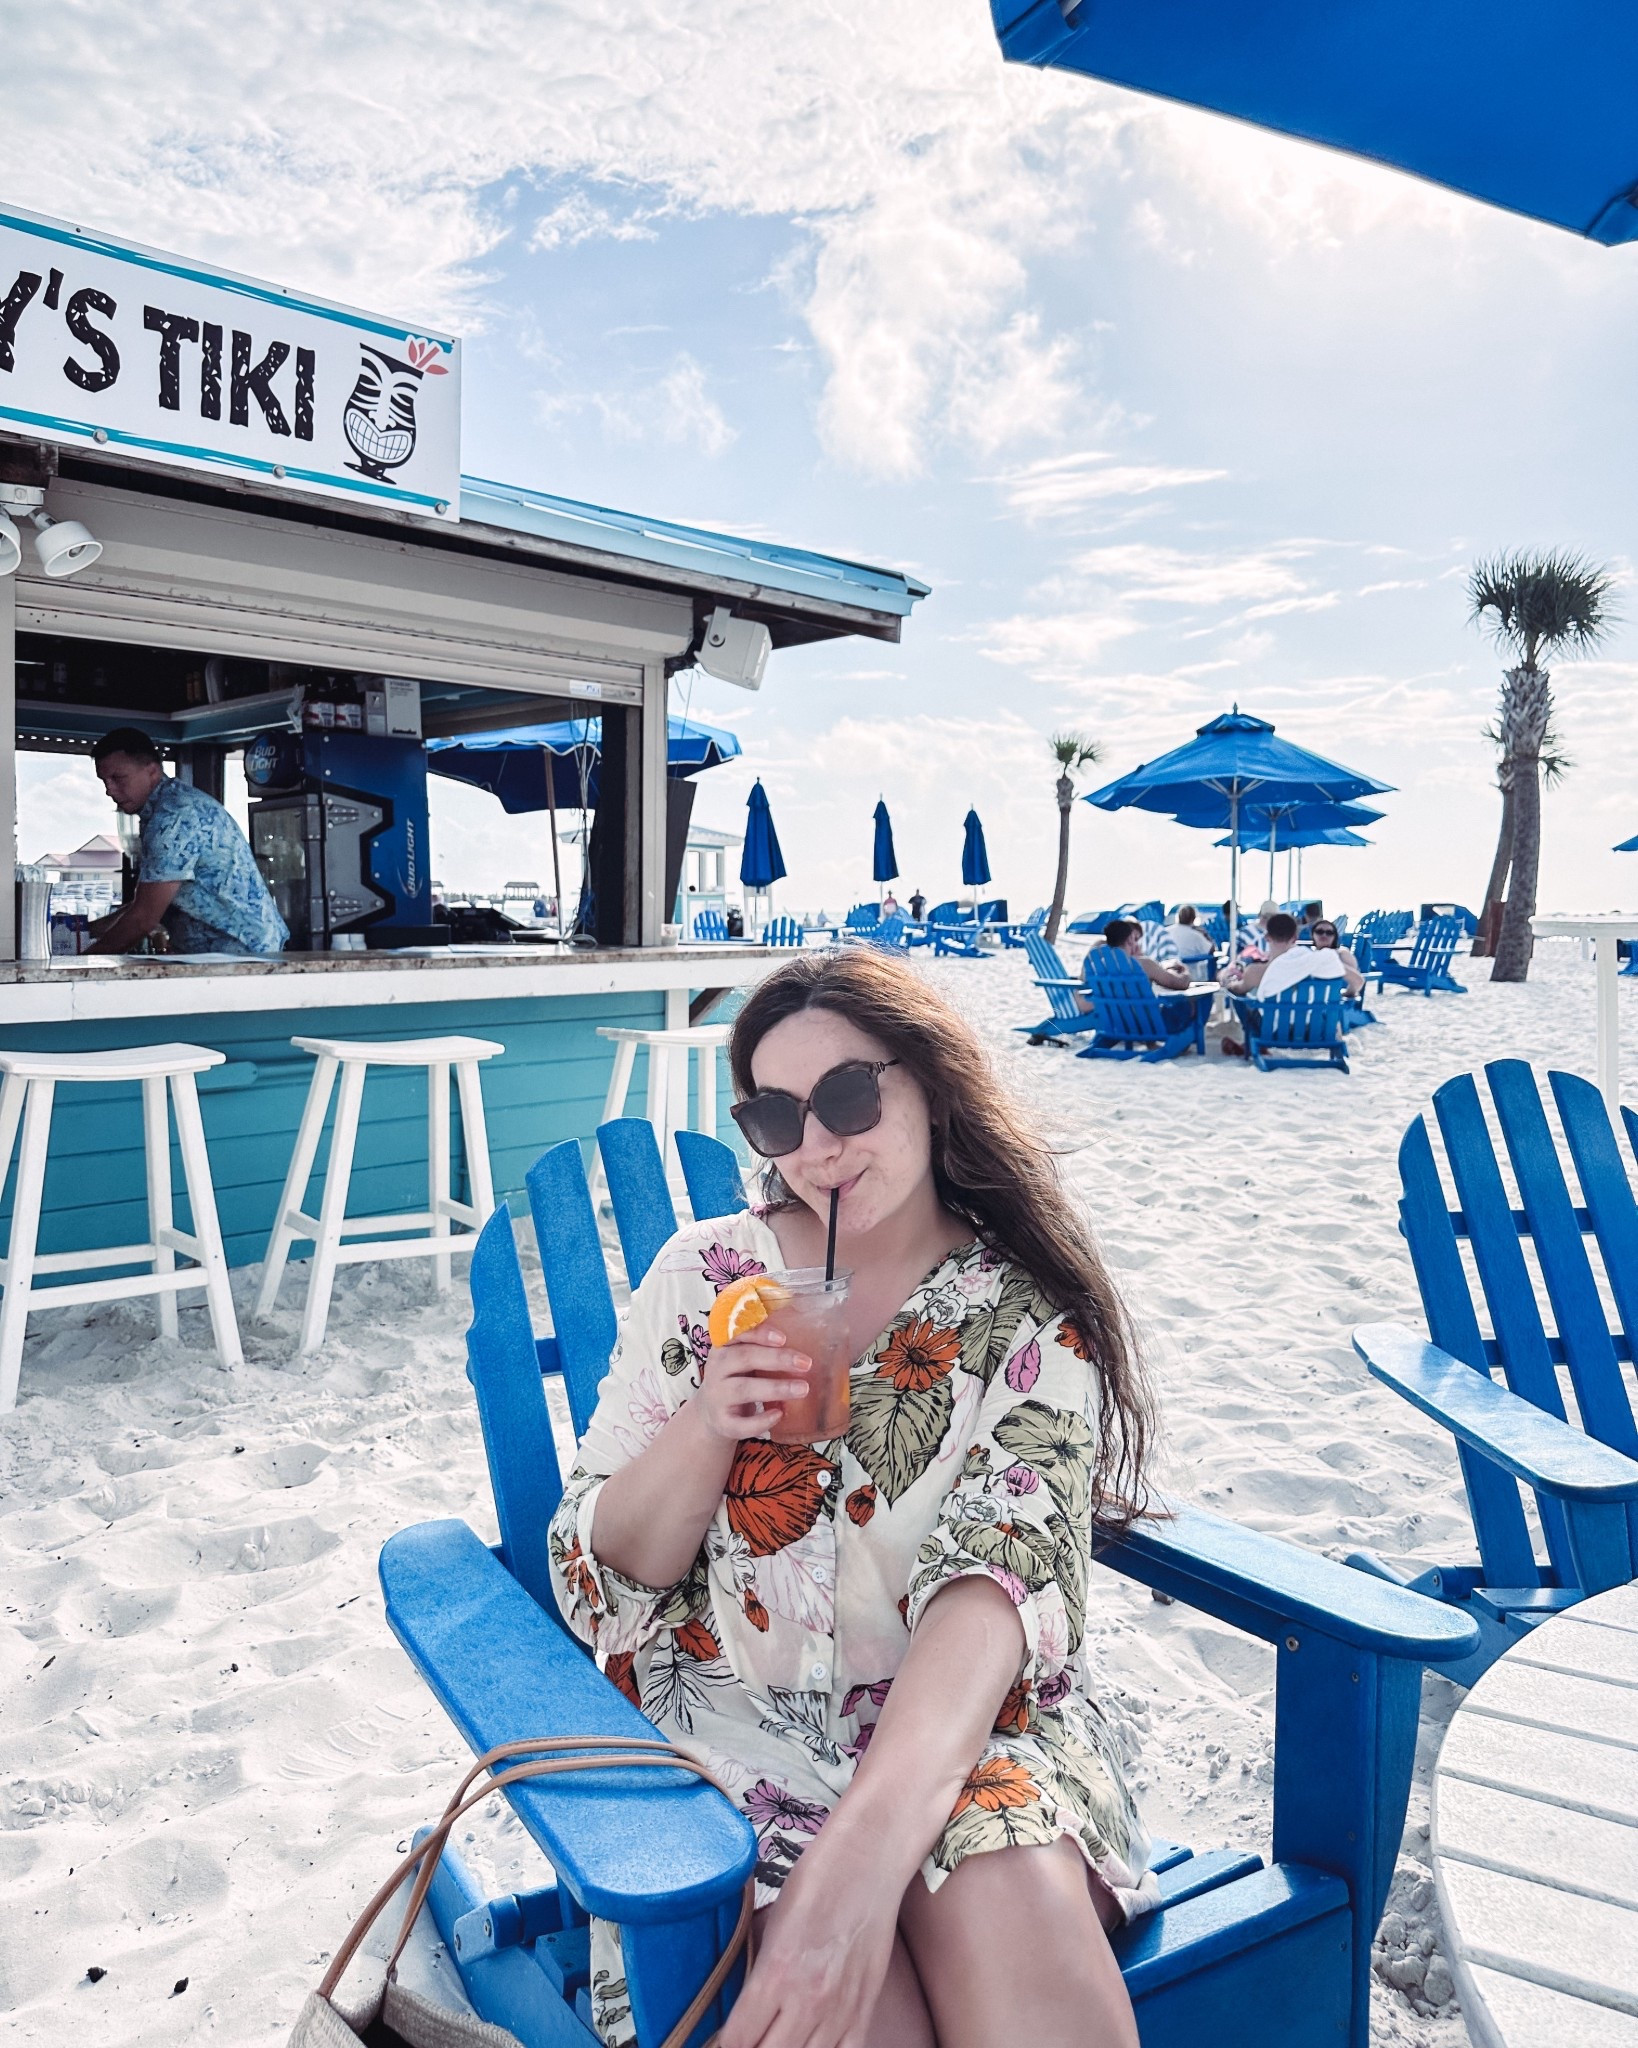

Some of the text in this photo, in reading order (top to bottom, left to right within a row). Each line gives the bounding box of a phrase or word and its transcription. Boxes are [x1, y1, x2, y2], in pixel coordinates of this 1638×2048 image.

[143, 304, 315, 441] TIKI
[250, 757, 279, 770] LIGHT
[254, 746, 276, 757] BUD
[406, 817, 416, 896] BUD LIGHT
